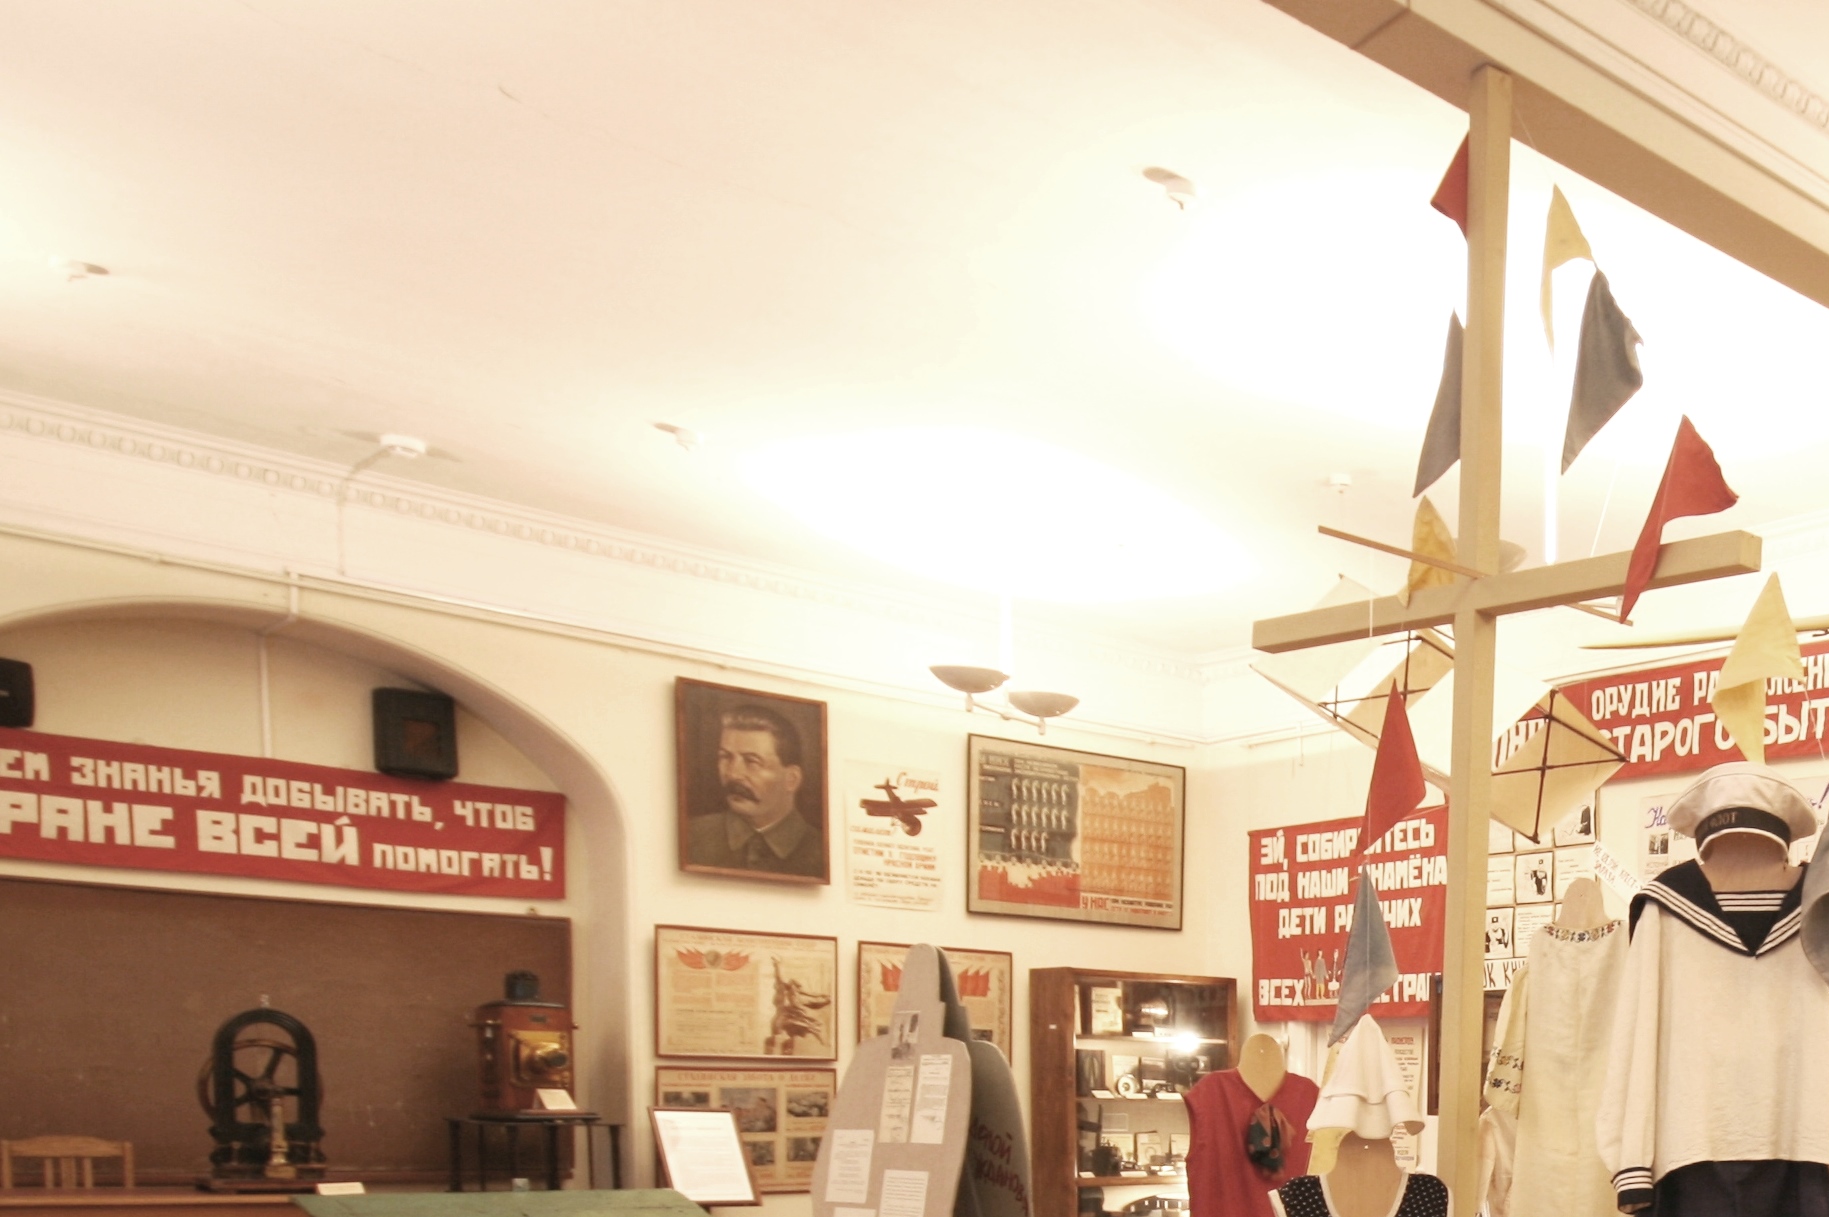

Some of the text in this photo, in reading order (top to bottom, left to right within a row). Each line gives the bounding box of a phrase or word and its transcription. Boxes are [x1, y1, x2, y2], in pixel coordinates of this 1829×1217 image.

[1591, 677, 1682, 720] ОРУДИЕ
[70, 755, 222, 799] ЗНАНЬЯ
[240, 774, 445, 832] ДОБЫВАТЬ,
[453, 799, 536, 833] ЧТОБ
[196, 810, 360, 867] ВСЕЙ
[373, 842, 554, 882] ПОМОГАТЬ!
[1260, 818, 1435, 871] ЭЙ, СОБИРТЕСЬ
[1255, 872, 1290, 902] ПОД
[1297, 867, 1349, 899] НАШИ
[1358, 854, 1447, 892] НАМЁНА
[1278, 906, 1327, 939] ДЕТИ
[1259, 978, 1305, 1006] ВСЕХ
